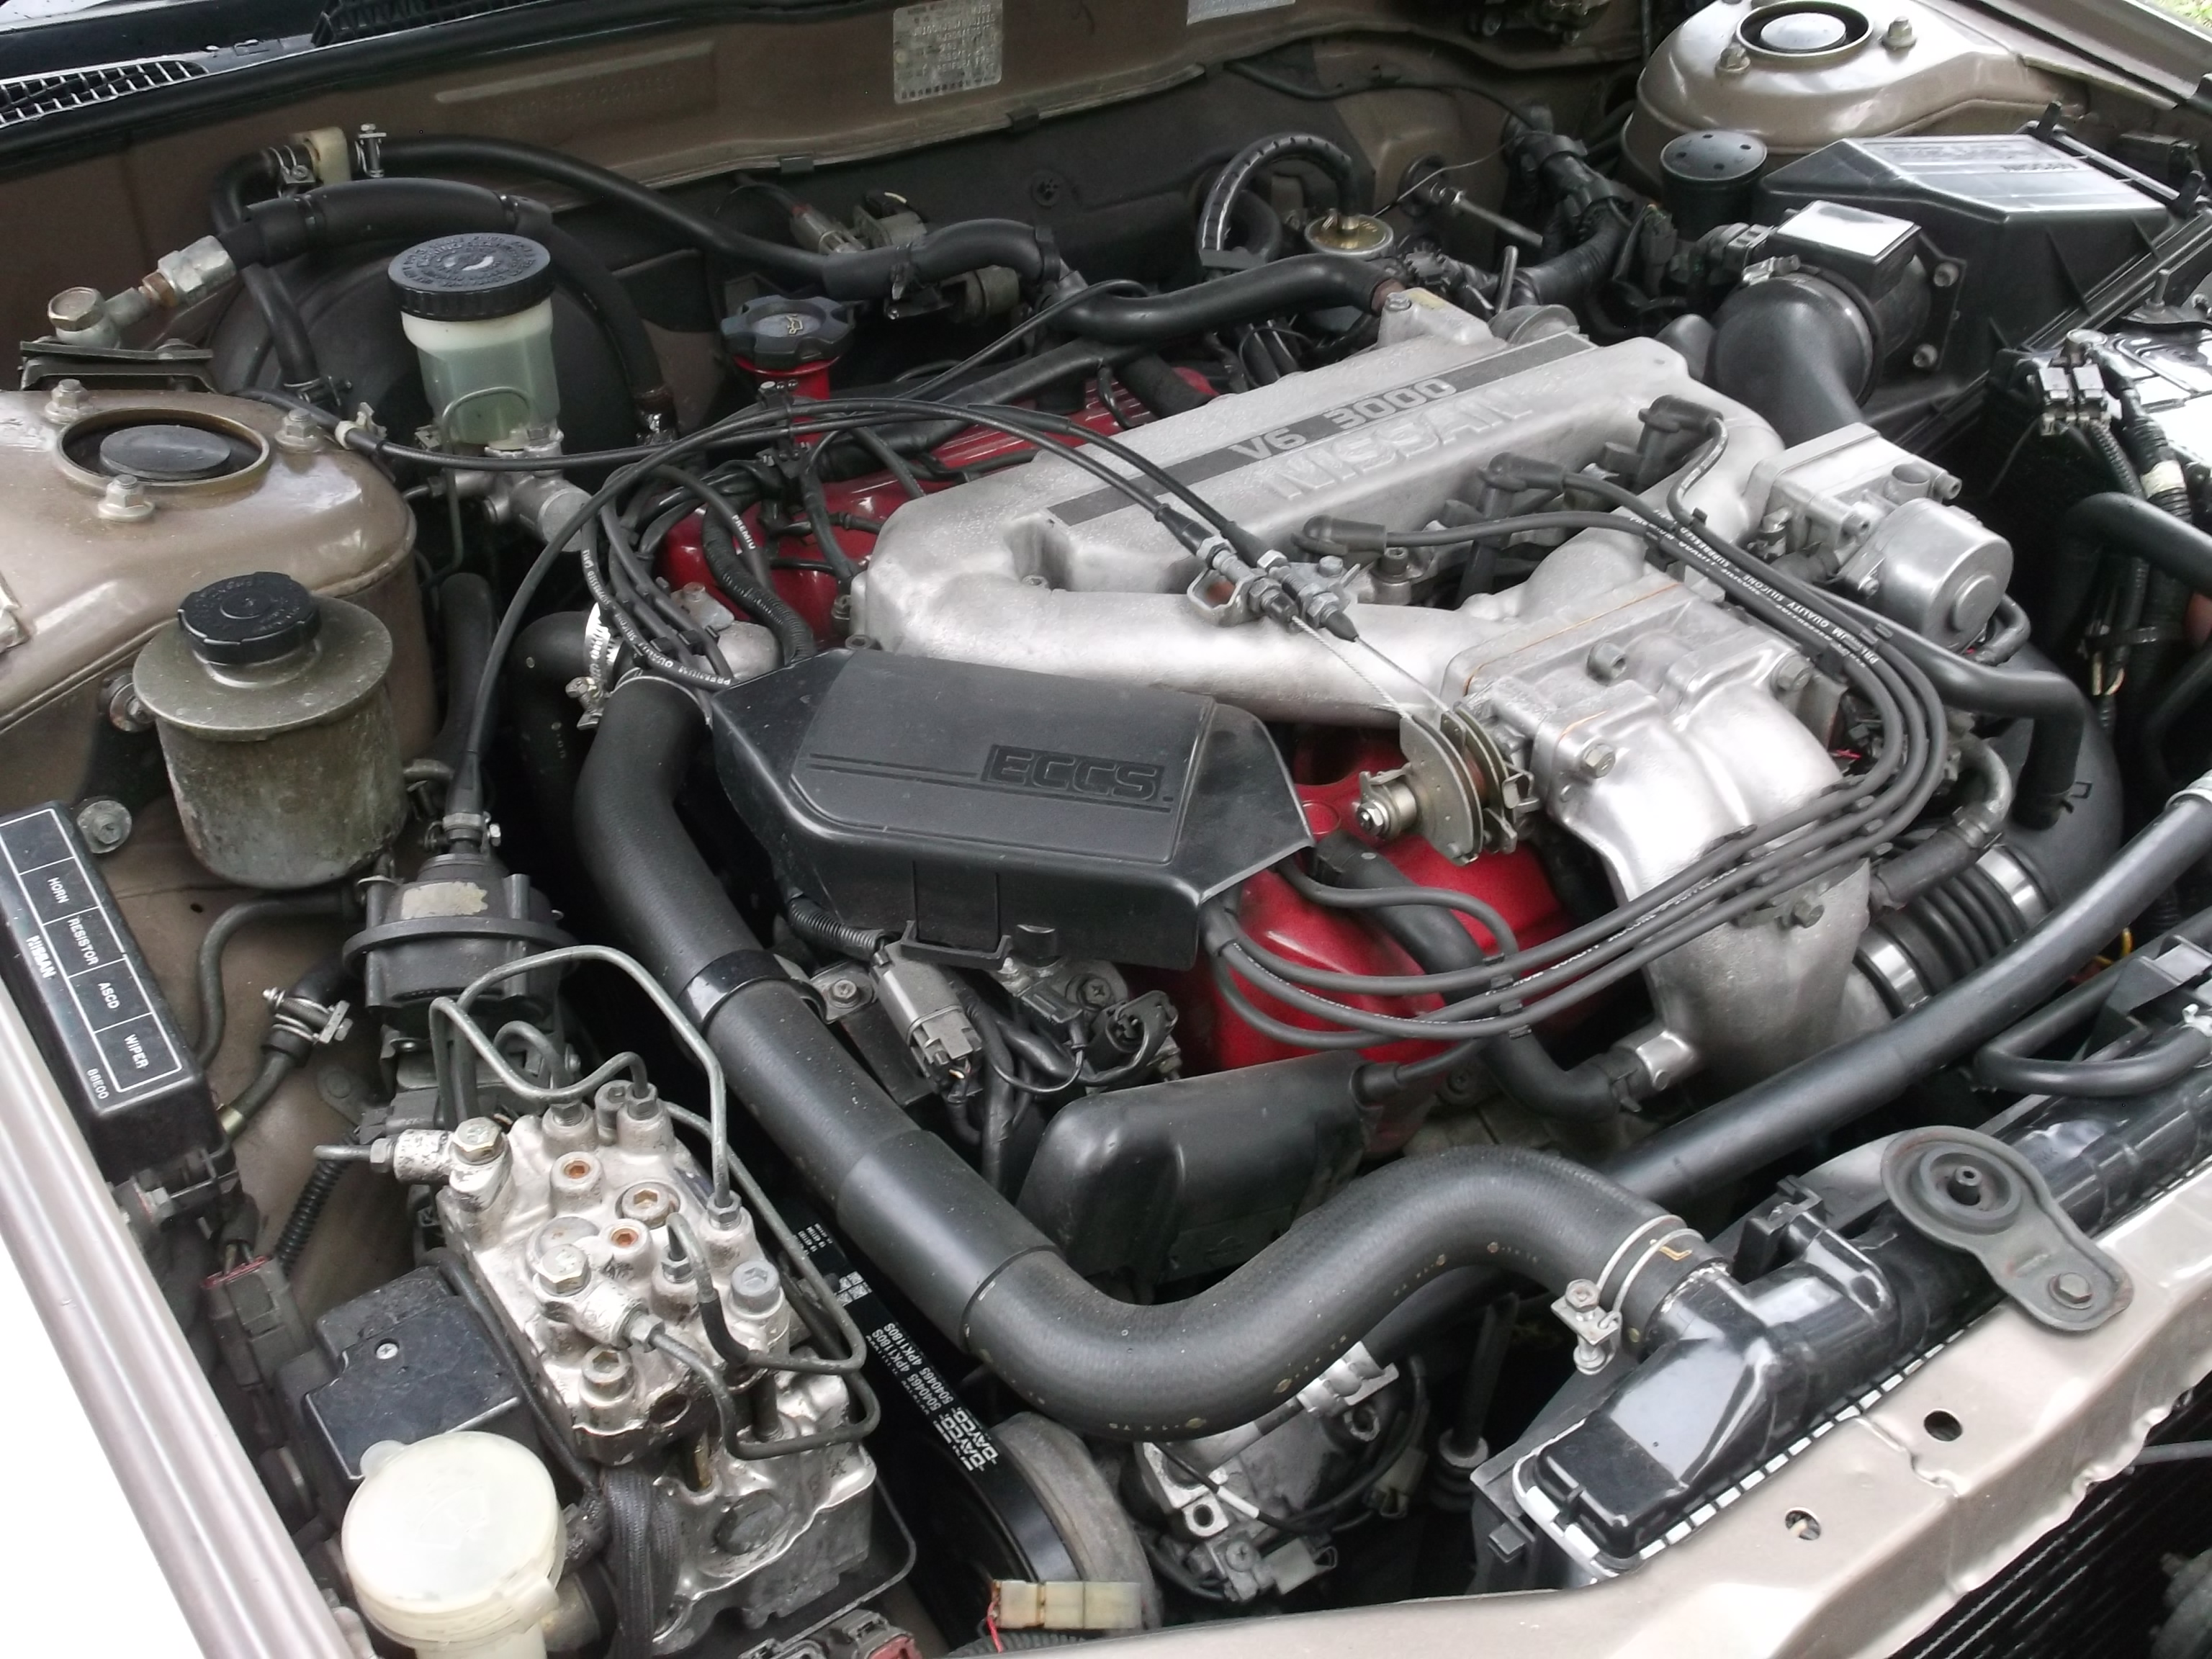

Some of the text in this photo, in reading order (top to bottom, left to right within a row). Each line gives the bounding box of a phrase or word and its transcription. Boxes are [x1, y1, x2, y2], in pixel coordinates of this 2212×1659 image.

[1228, 378, 1457, 460] V6 3000
[1257, 387, 1534, 500] NISSAN
[1679, 526, 1730, 567] SUPPRESSED
[1786, 601, 1830, 628] QUALITY
[678, 665, 732, 685] PREMIUM
[988, 747, 1157, 801] ECCS
[47, 877, 70, 904] HORN
[26, 935, 57, 979] NISSAN
[67, 917, 99, 966] RESISTOR
[98, 981, 120, 1010] ASCD
[124, 1034, 149, 1069] WIPER
[872, 1328, 910, 1372] 4PK1180S
[884, 1322, 922, 1366] 4PK1180S
[907, 1373, 941, 1411] 5040465
[919, 1367, 954, 1405] 5040465
